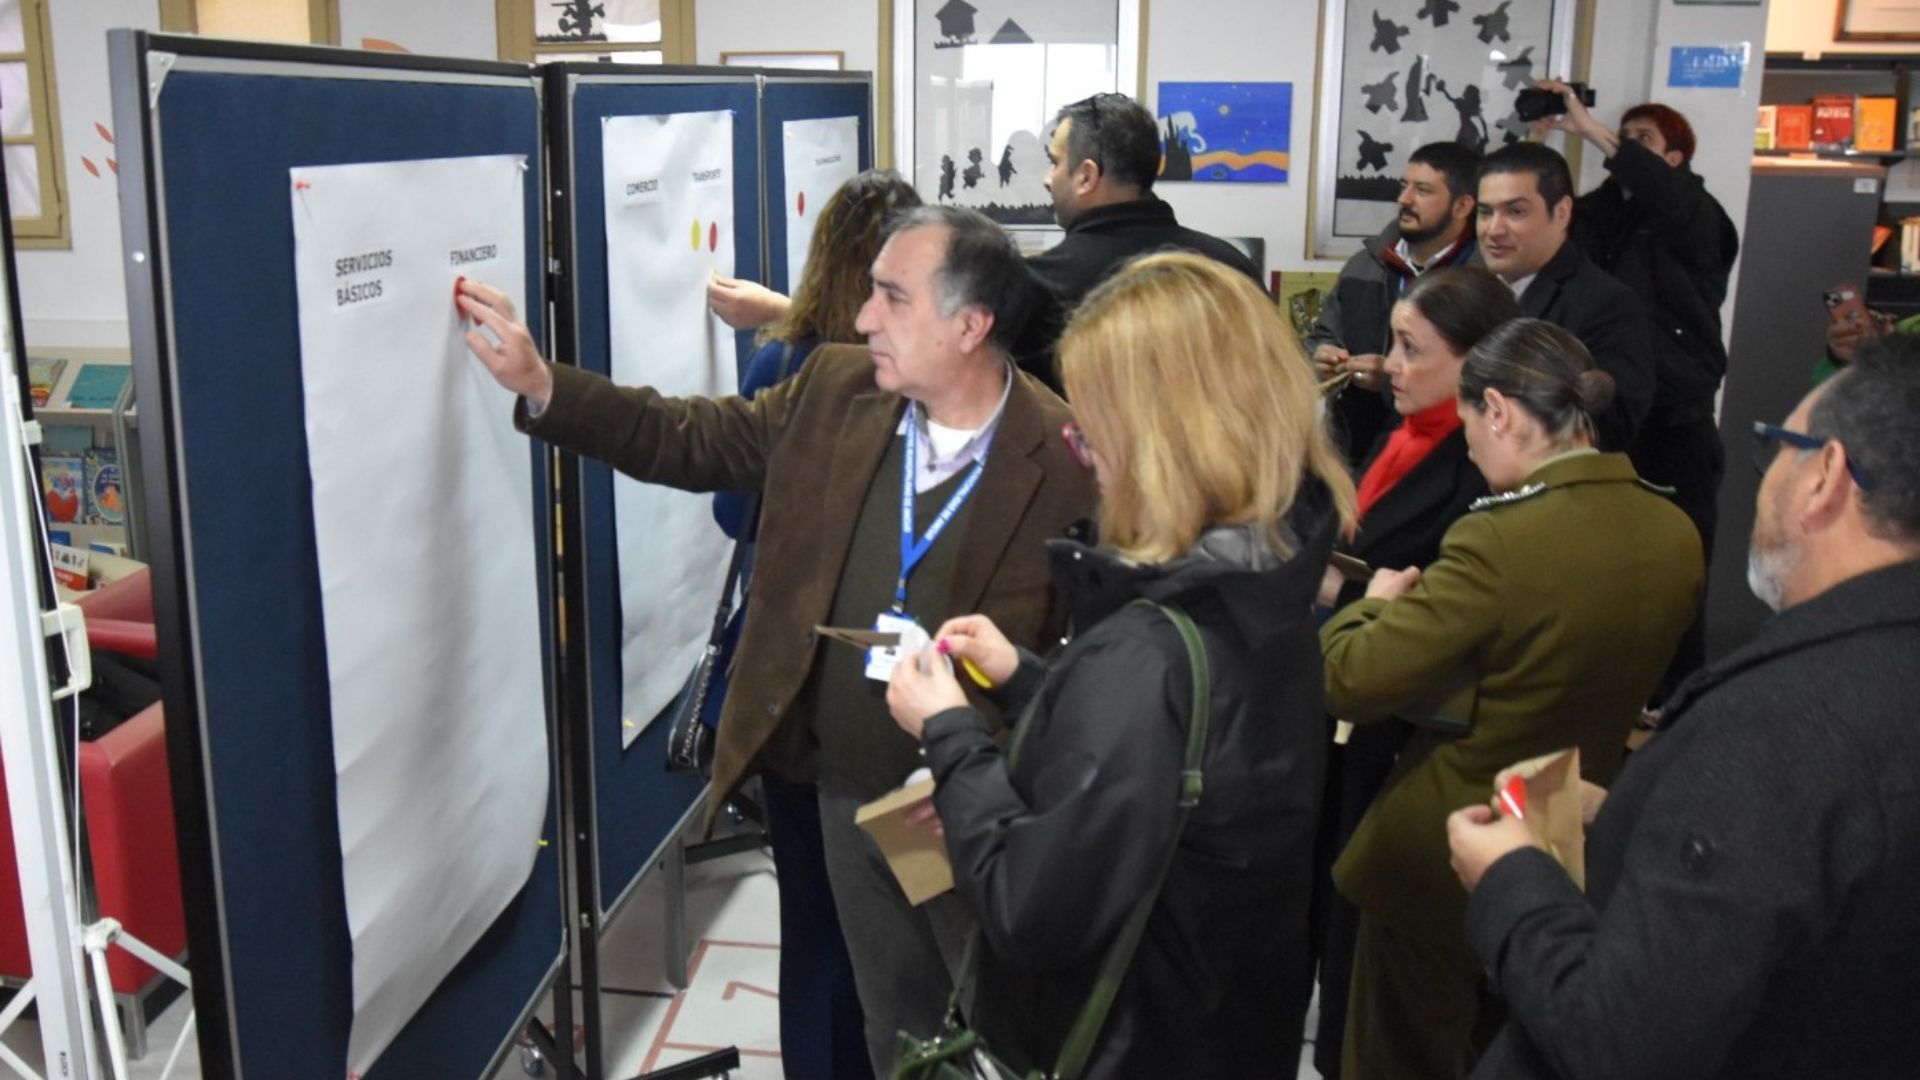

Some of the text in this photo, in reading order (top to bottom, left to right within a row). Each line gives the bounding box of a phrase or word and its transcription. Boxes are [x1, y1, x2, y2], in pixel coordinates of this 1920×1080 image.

[626, 179, 659, 196] COMERCIO
[335, 250, 393, 277] SERVICIOS
[450, 244, 497, 267] FINANCIERO
[336, 280, 383, 306] BÁSICOS
